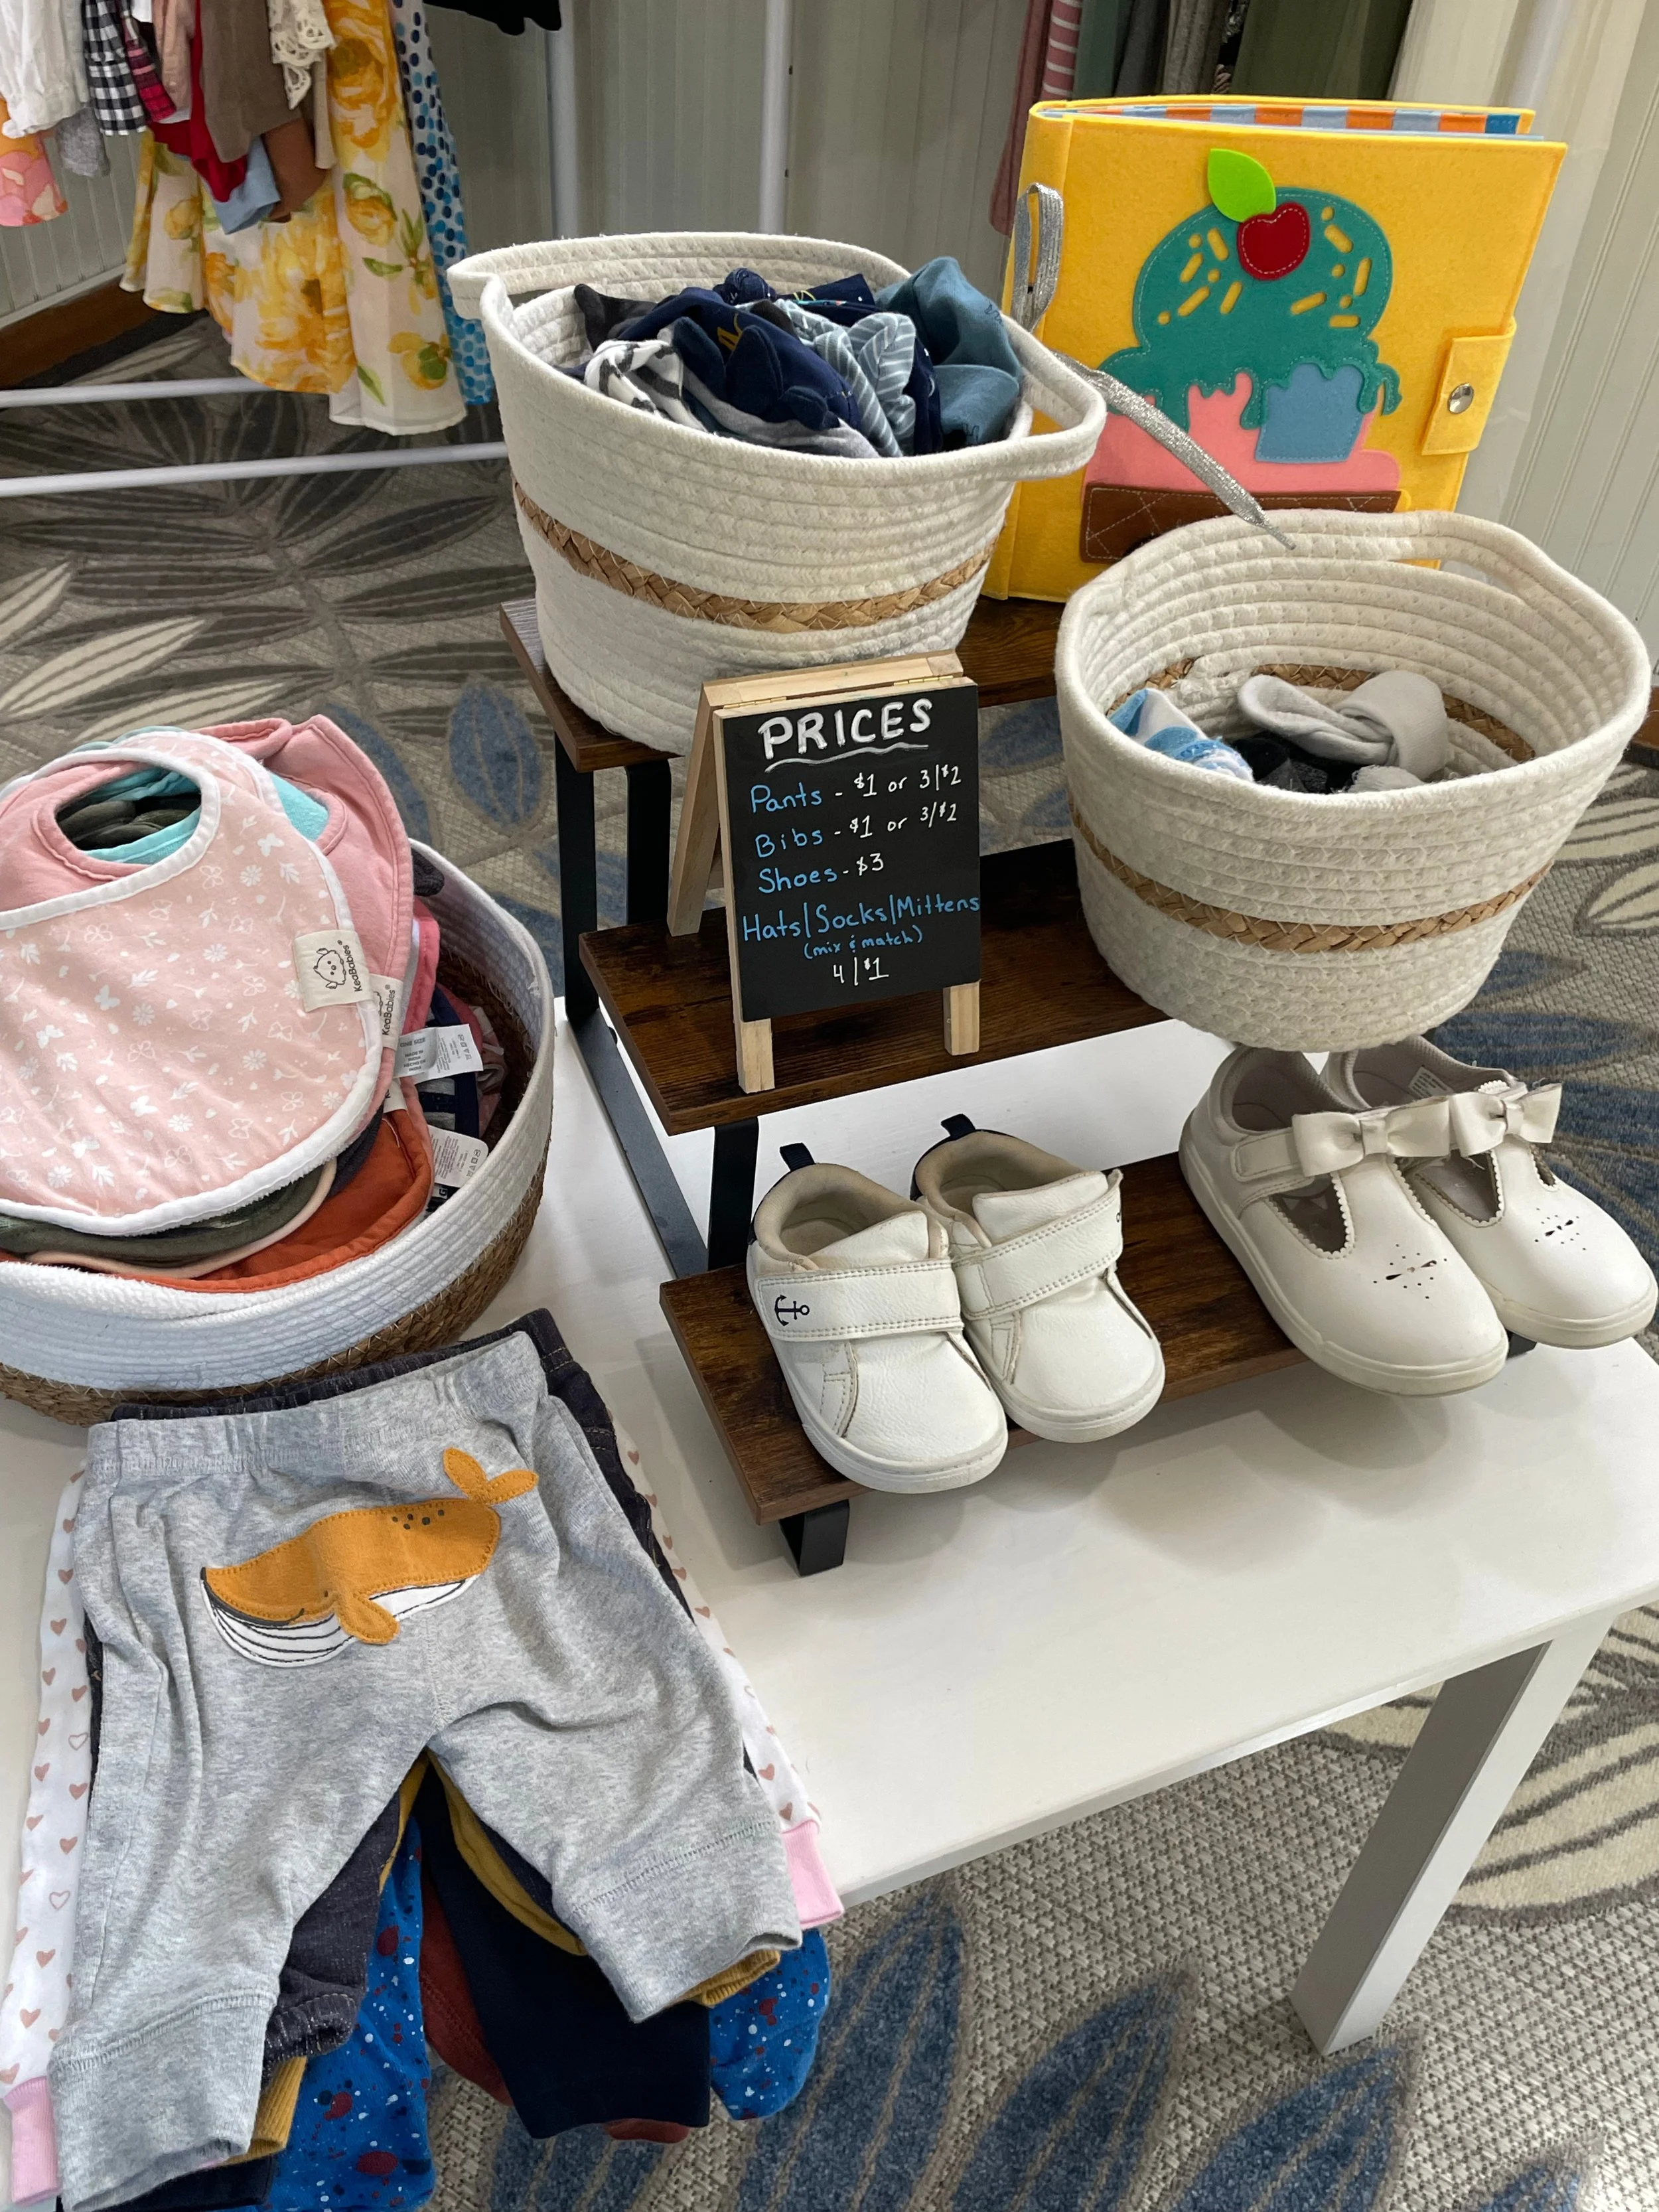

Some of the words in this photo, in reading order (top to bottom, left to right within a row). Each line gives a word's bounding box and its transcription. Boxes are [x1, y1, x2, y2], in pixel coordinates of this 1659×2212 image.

[758, 698, 932, 759] PRICES
[750, 782, 822, 813] Pants
[854, 773, 877, 797] $1
[888, 776, 908, 792] or
[755, 828, 824, 857] Bibs
[849, 815, 873, 838] $1
[887, 817, 908, 832] or
[758, 867, 837, 894] Shoes
[856, 852, 884, 876] $3
[804, 942, 841, 960] (mix
[862, 924, 923, 948] match)
